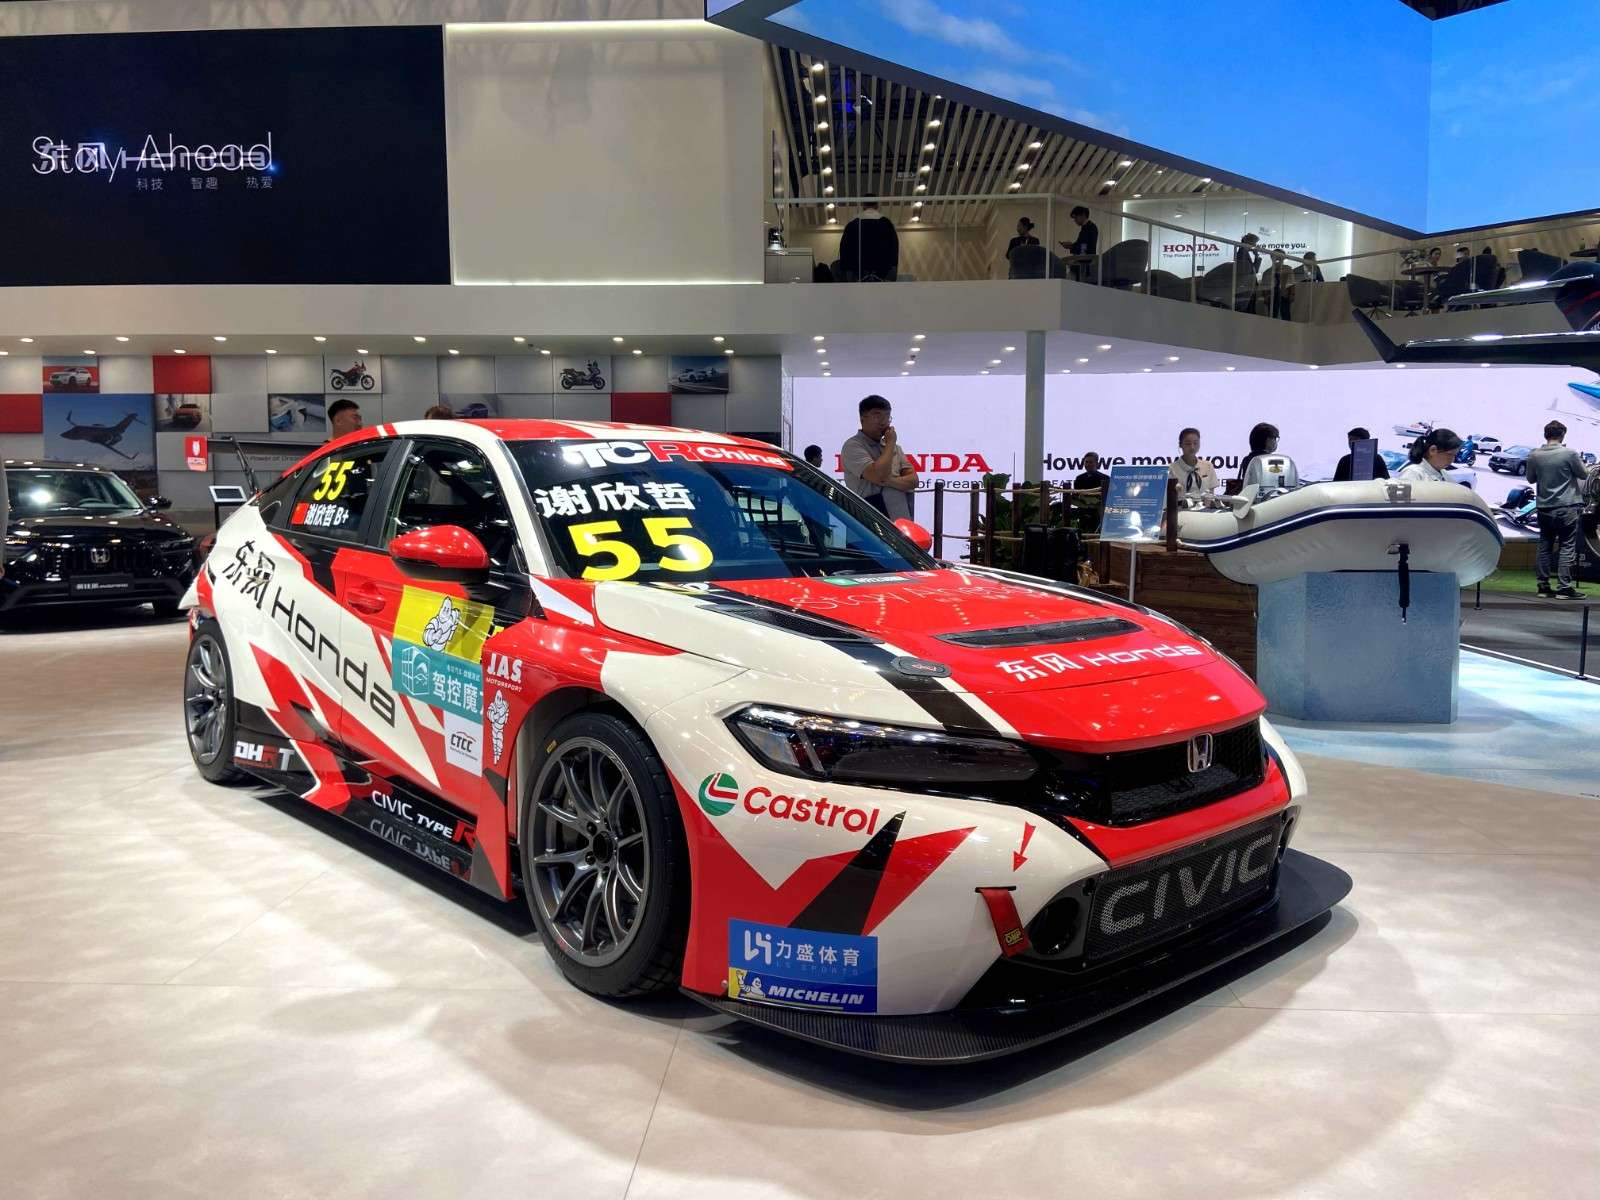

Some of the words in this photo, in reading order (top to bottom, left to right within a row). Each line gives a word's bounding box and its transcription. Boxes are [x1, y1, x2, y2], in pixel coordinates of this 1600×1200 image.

[32, 136, 123, 183] Stay
[136, 131, 272, 171] Ahead
[136, 177, 164, 191] 科技
[190, 177, 219, 190] 智趣
[246, 176, 273, 190] 热爱
[1163, 243, 1220, 252] HONDA
[561, 441, 702, 468] TCR
[697, 446, 787, 467] China
[313, 460, 355, 501] 55
[918, 479, 932, 489] of
[303, 503, 337, 527] 谢欣哲
[333, 506, 349, 526] B+
[534, 482, 696, 518] 谢欣哲
[567, 517, 714, 581] 55
[222, 540, 276, 610] 东风
[272, 586, 396, 728] Honda
[995, 652, 1084, 683] 东风
[1079, 643, 1203, 667] Honda
[432, 670, 484, 716] 驾控魔
[485, 677, 523, 693] MOTORSPORT
[450, 733, 473, 753] CTCC
[371, 790, 414, 821] CIVIC
[416, 813, 454, 839] TYPE
[743, 786, 880, 836] Castrol
[1100, 833, 1273, 936] CIVIC
[775, 940, 860, 967] 力盛体育
[768, 985, 865, 1006] MICHELIN
